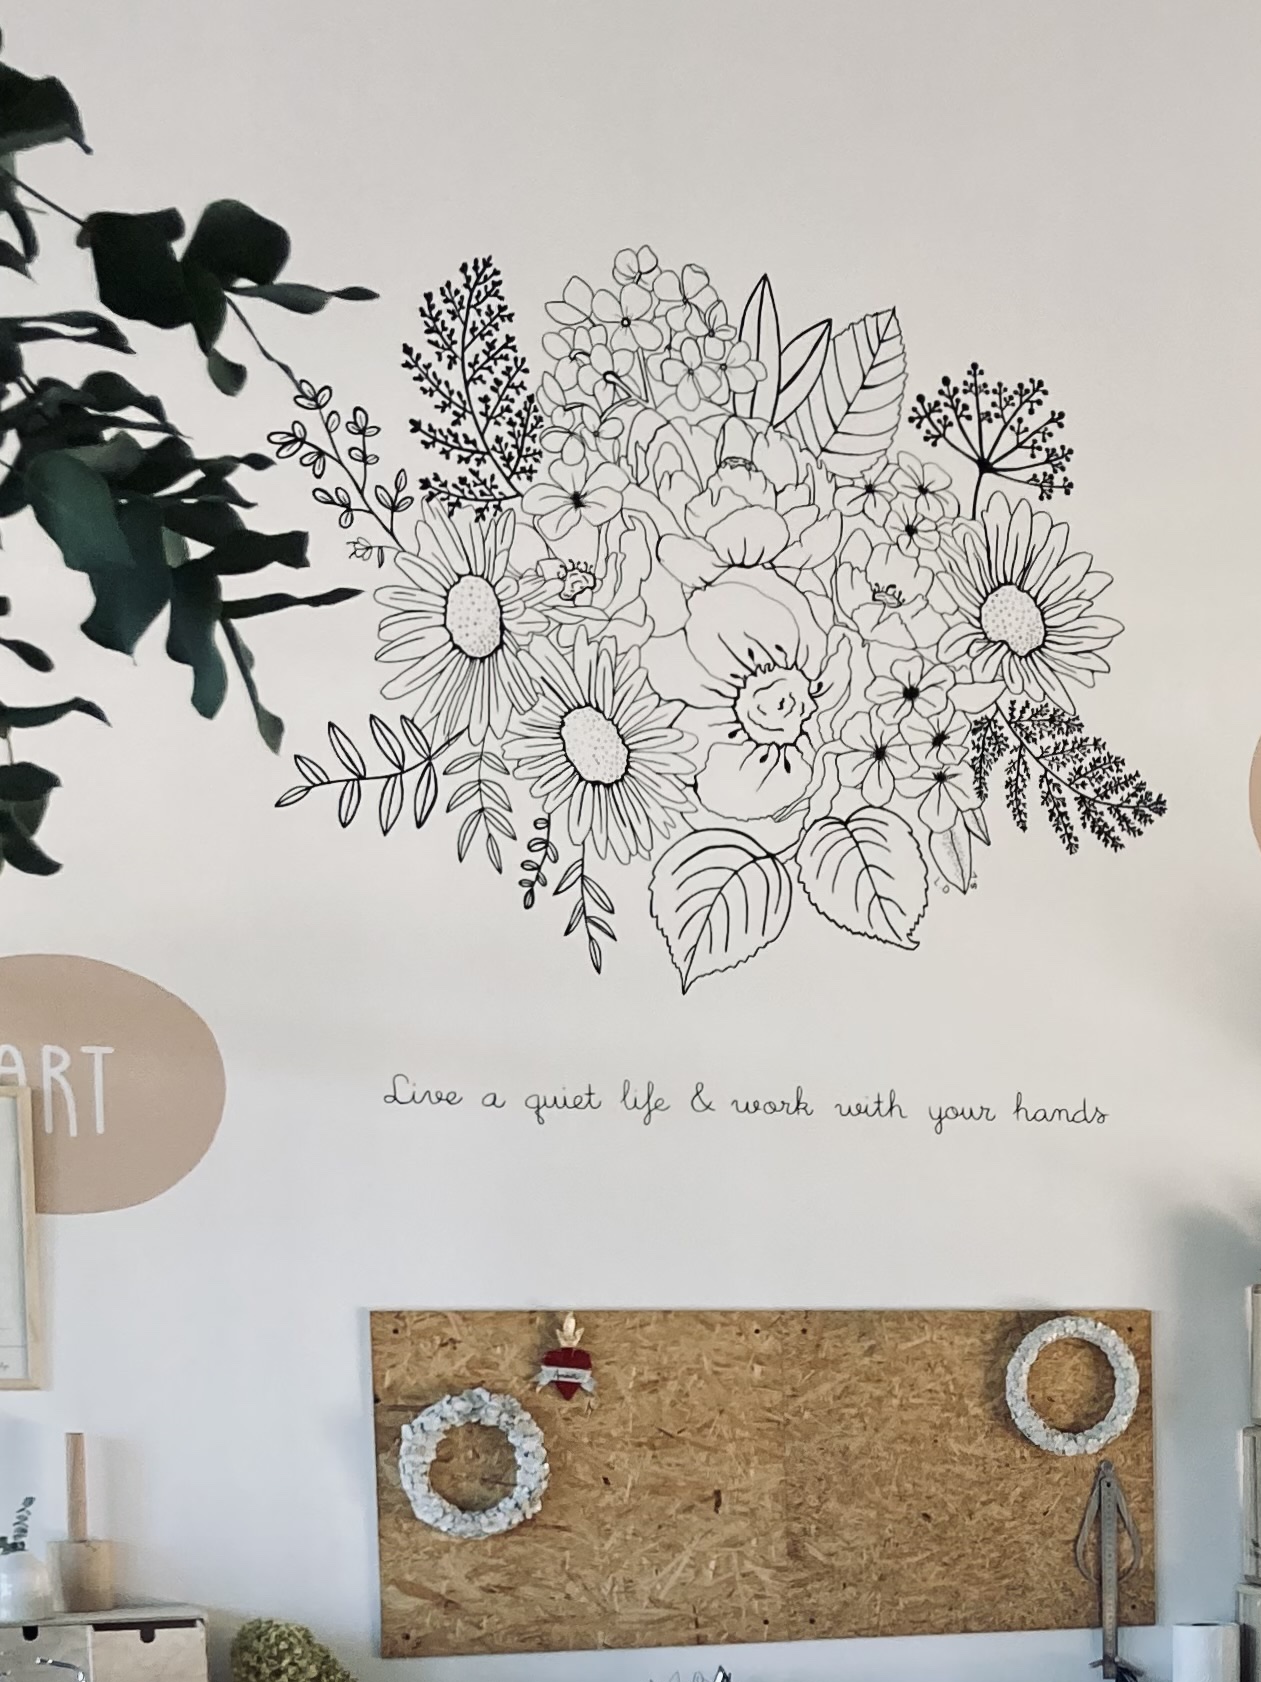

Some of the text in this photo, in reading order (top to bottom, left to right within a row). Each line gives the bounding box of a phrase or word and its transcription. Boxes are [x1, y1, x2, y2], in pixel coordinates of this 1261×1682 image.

[383, 1073, 1110, 1135] Live a quiet life & work with your hands
